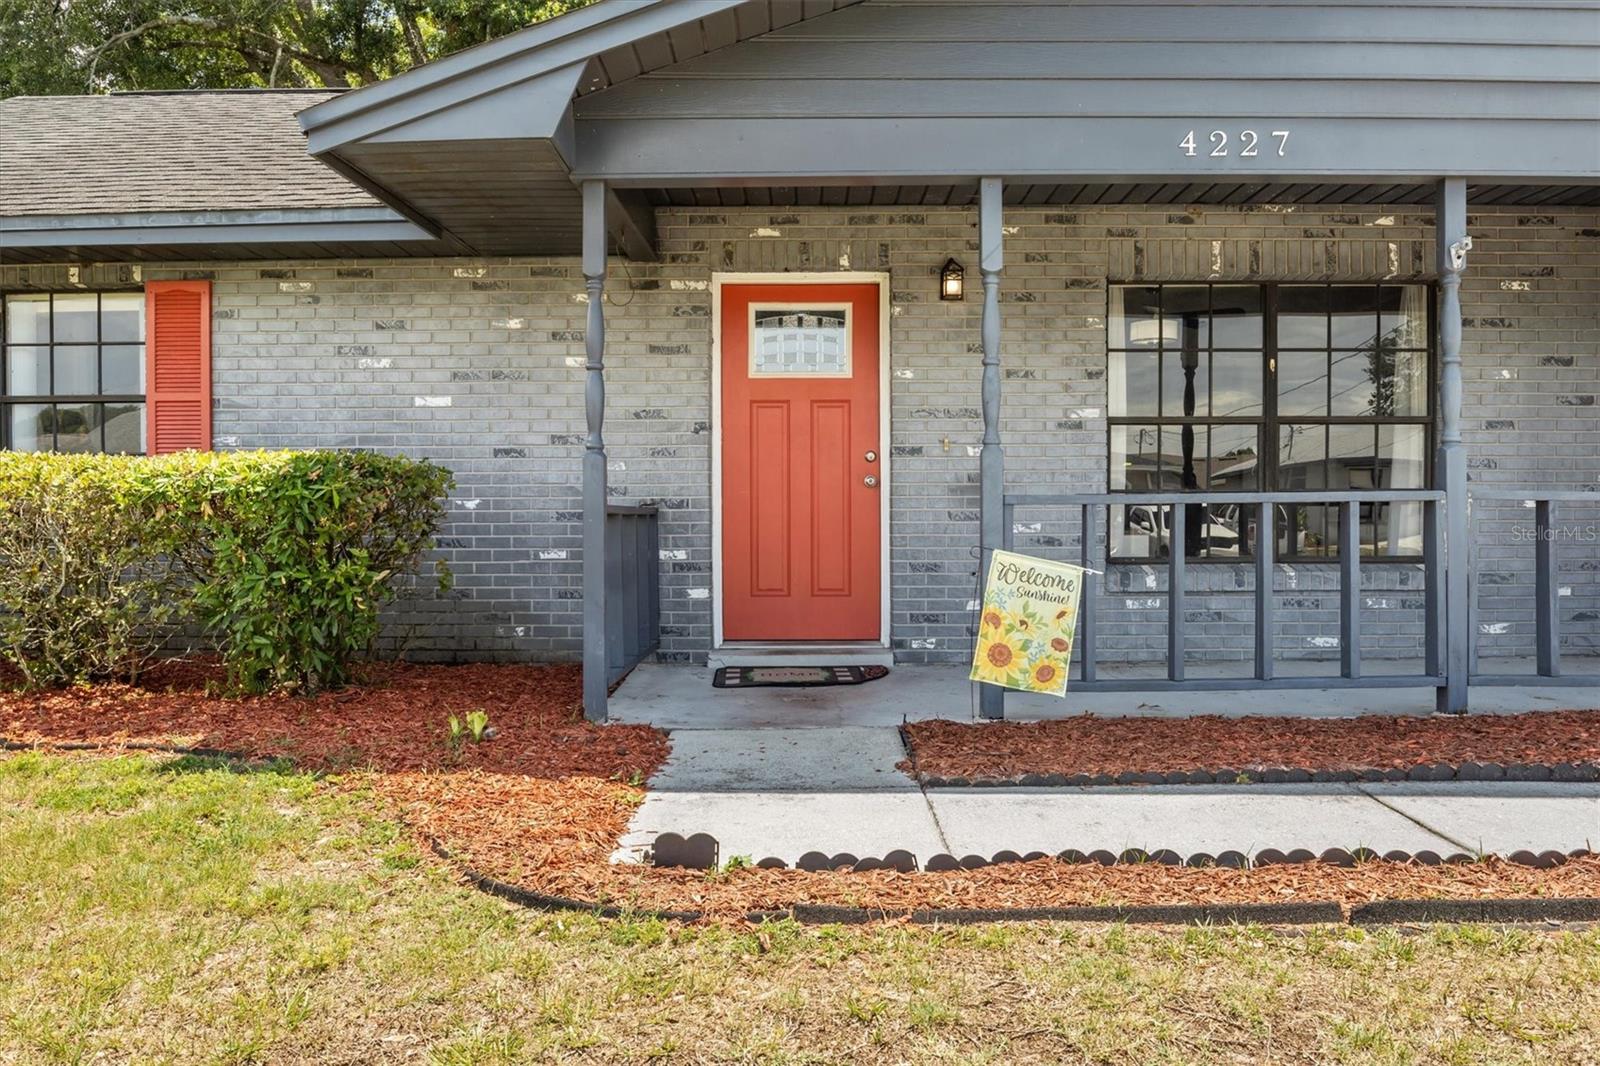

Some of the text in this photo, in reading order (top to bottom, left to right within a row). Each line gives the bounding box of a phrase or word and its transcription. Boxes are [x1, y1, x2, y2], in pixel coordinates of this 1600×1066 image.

[1178, 130, 1290, 157] 4227
[997, 562, 1075, 592] Welcome
[1016, 586, 1070, 604] Sunshine!
